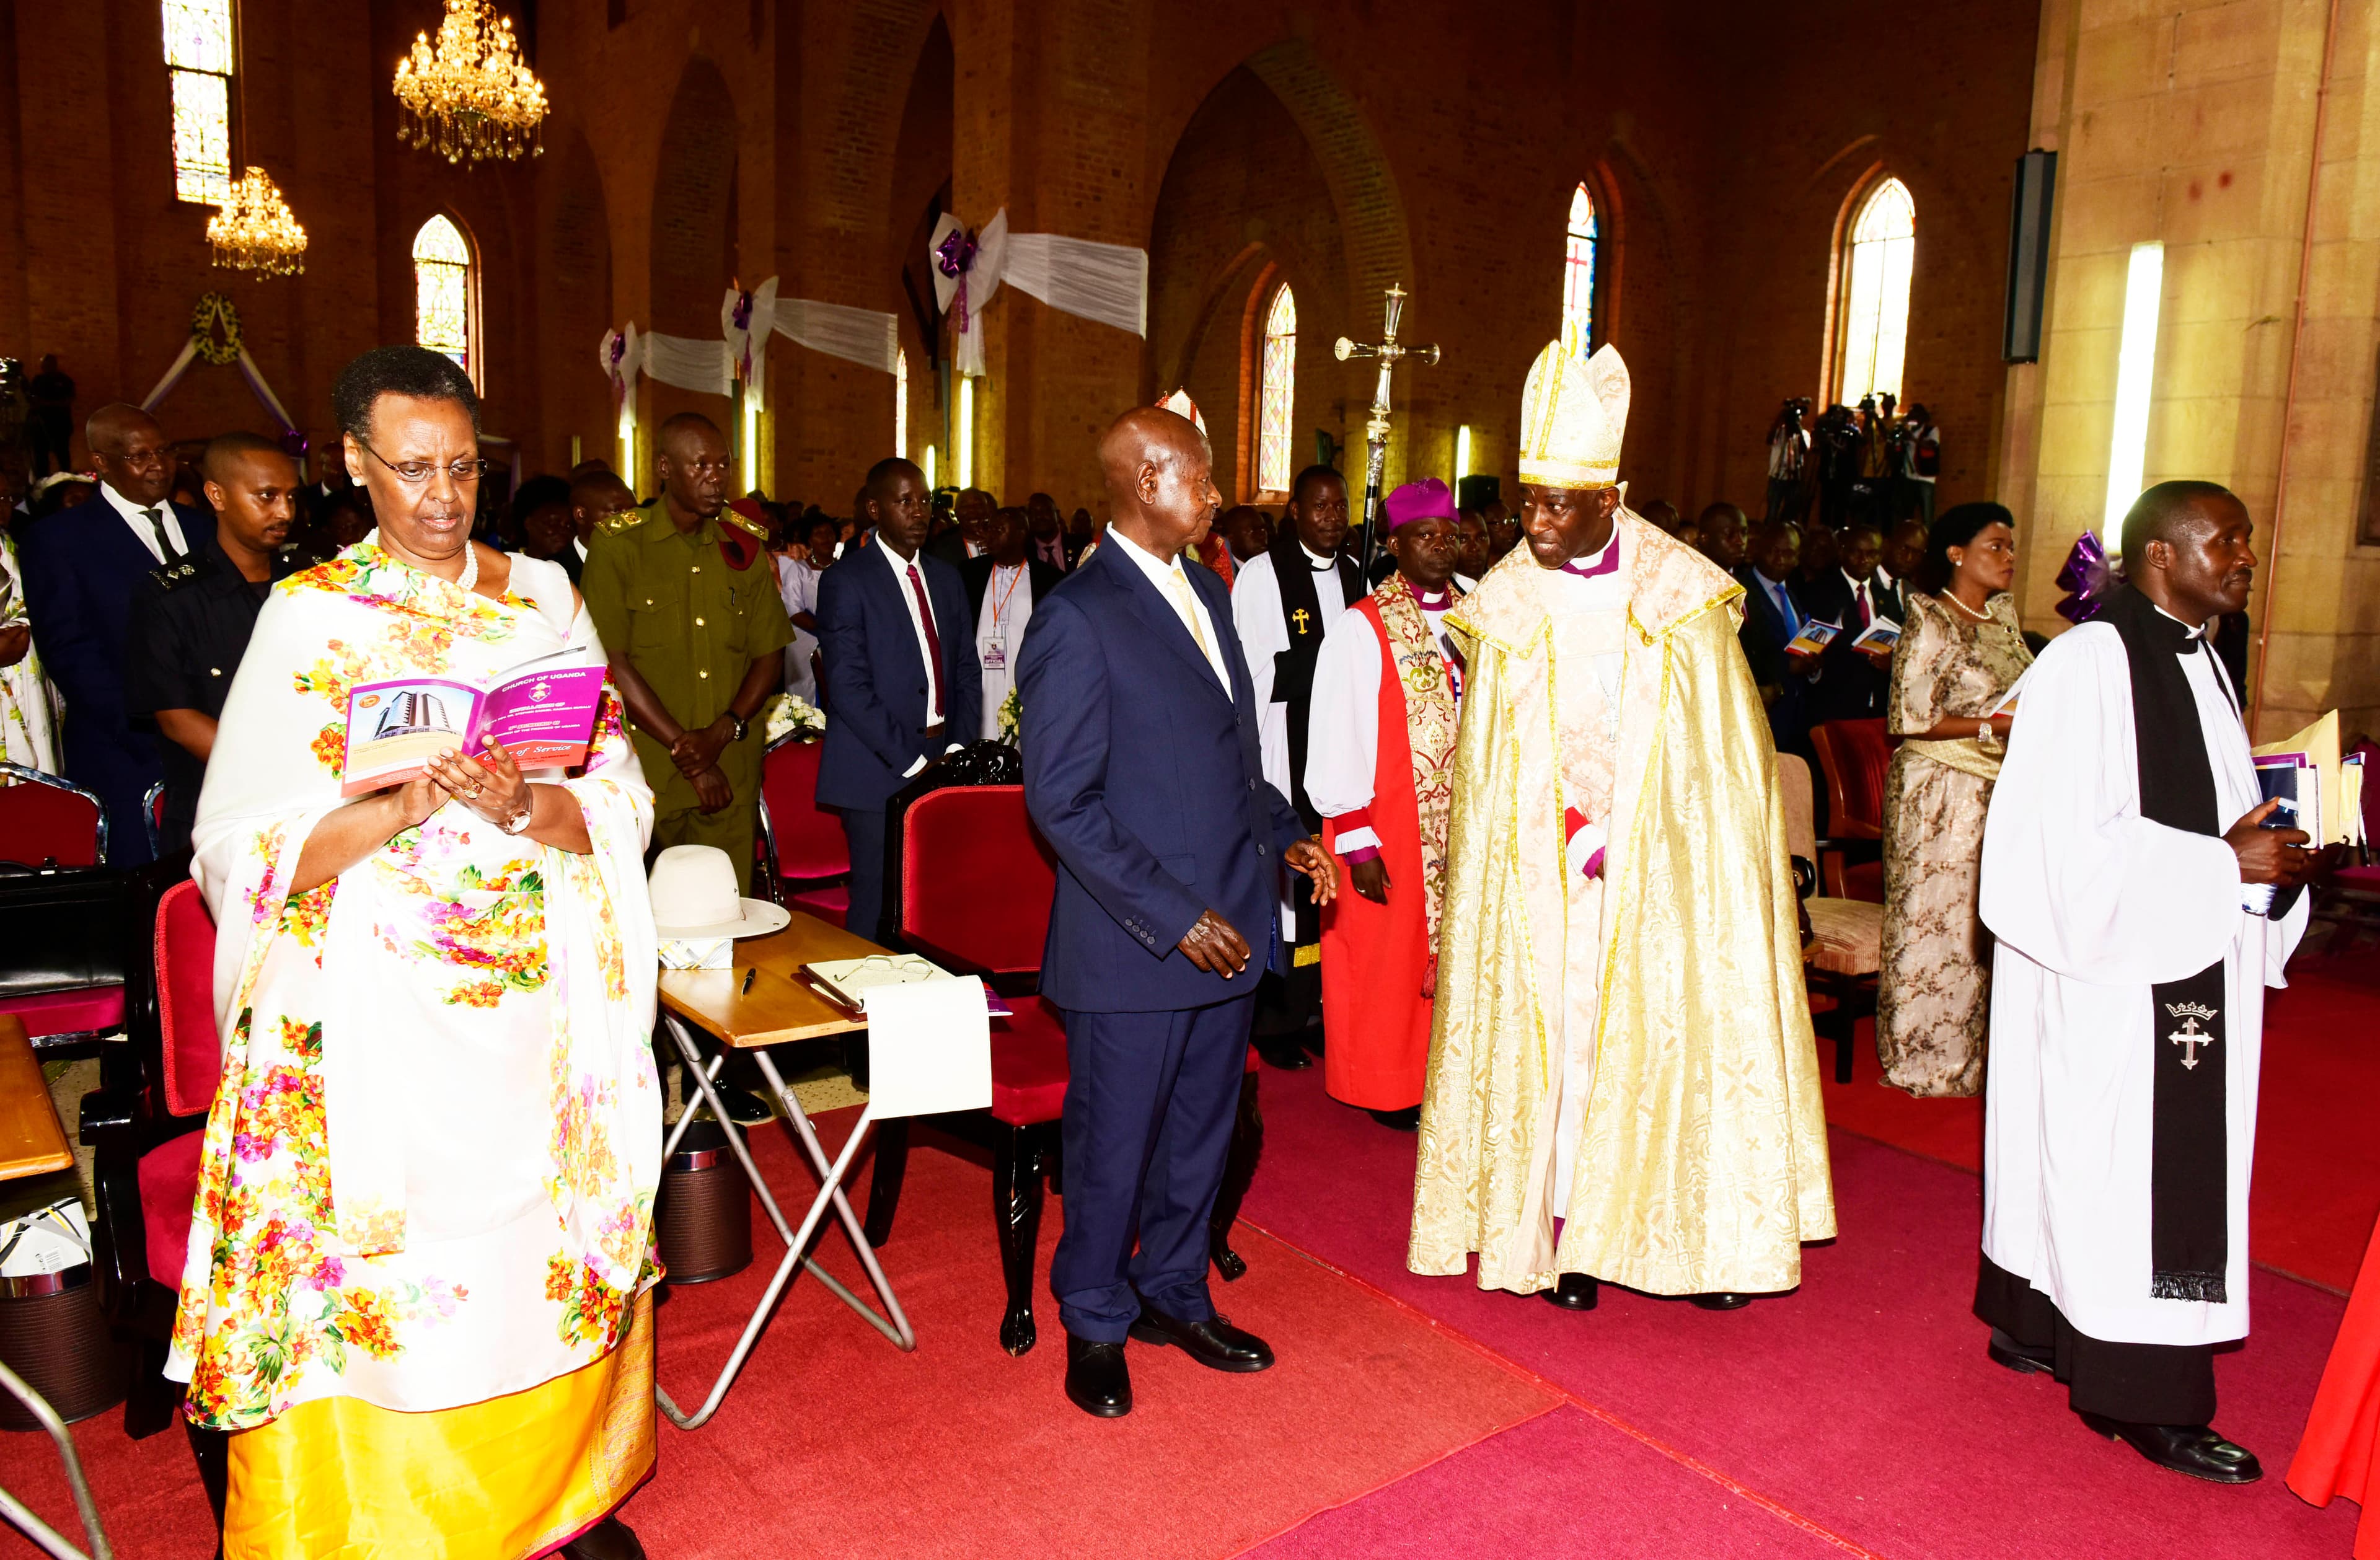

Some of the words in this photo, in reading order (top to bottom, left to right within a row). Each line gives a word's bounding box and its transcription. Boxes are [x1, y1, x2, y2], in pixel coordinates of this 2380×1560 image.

[501, 677, 535, 692] CHURCH
[516, 747, 531, 757] of
[533, 744, 572, 754] Service
